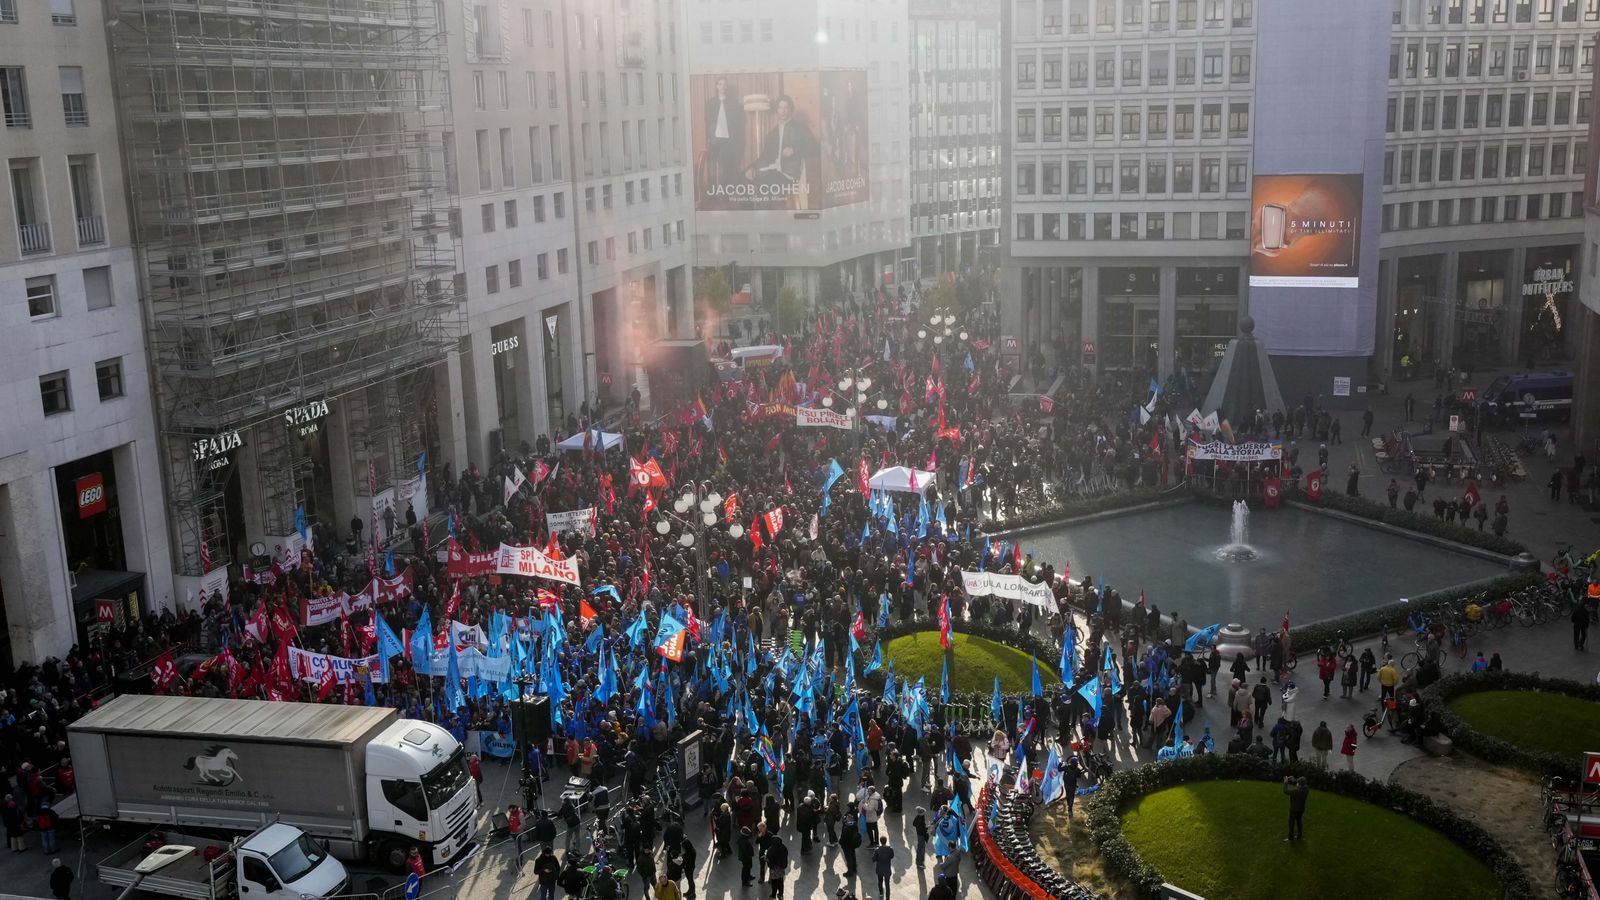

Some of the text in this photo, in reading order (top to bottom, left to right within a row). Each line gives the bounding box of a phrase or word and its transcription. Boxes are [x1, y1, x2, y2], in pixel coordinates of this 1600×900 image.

[706, 179, 810, 195] JACOB COHËN
[826, 181, 845, 194] JACOB
[1534, 268, 1564, 281] URBAN
[1522, 280, 1574, 296] OUTFITTERS
[491, 336, 519, 355] GUESS
[285, 399, 329, 427] SPADA
[819, 411, 851, 422] PIRELL
[807, 417, 847, 427] BOLLATE
[301, 424, 318, 437] ROMA
[192, 430, 242, 461] SPADA
[79, 485, 102, 506] LEGO
[520, 549, 534, 560] SPI
[518, 560, 577, 582] MILANO
[1004, 583, 1045, 598] LOMBARD
[99, 605, 113, 618] M
